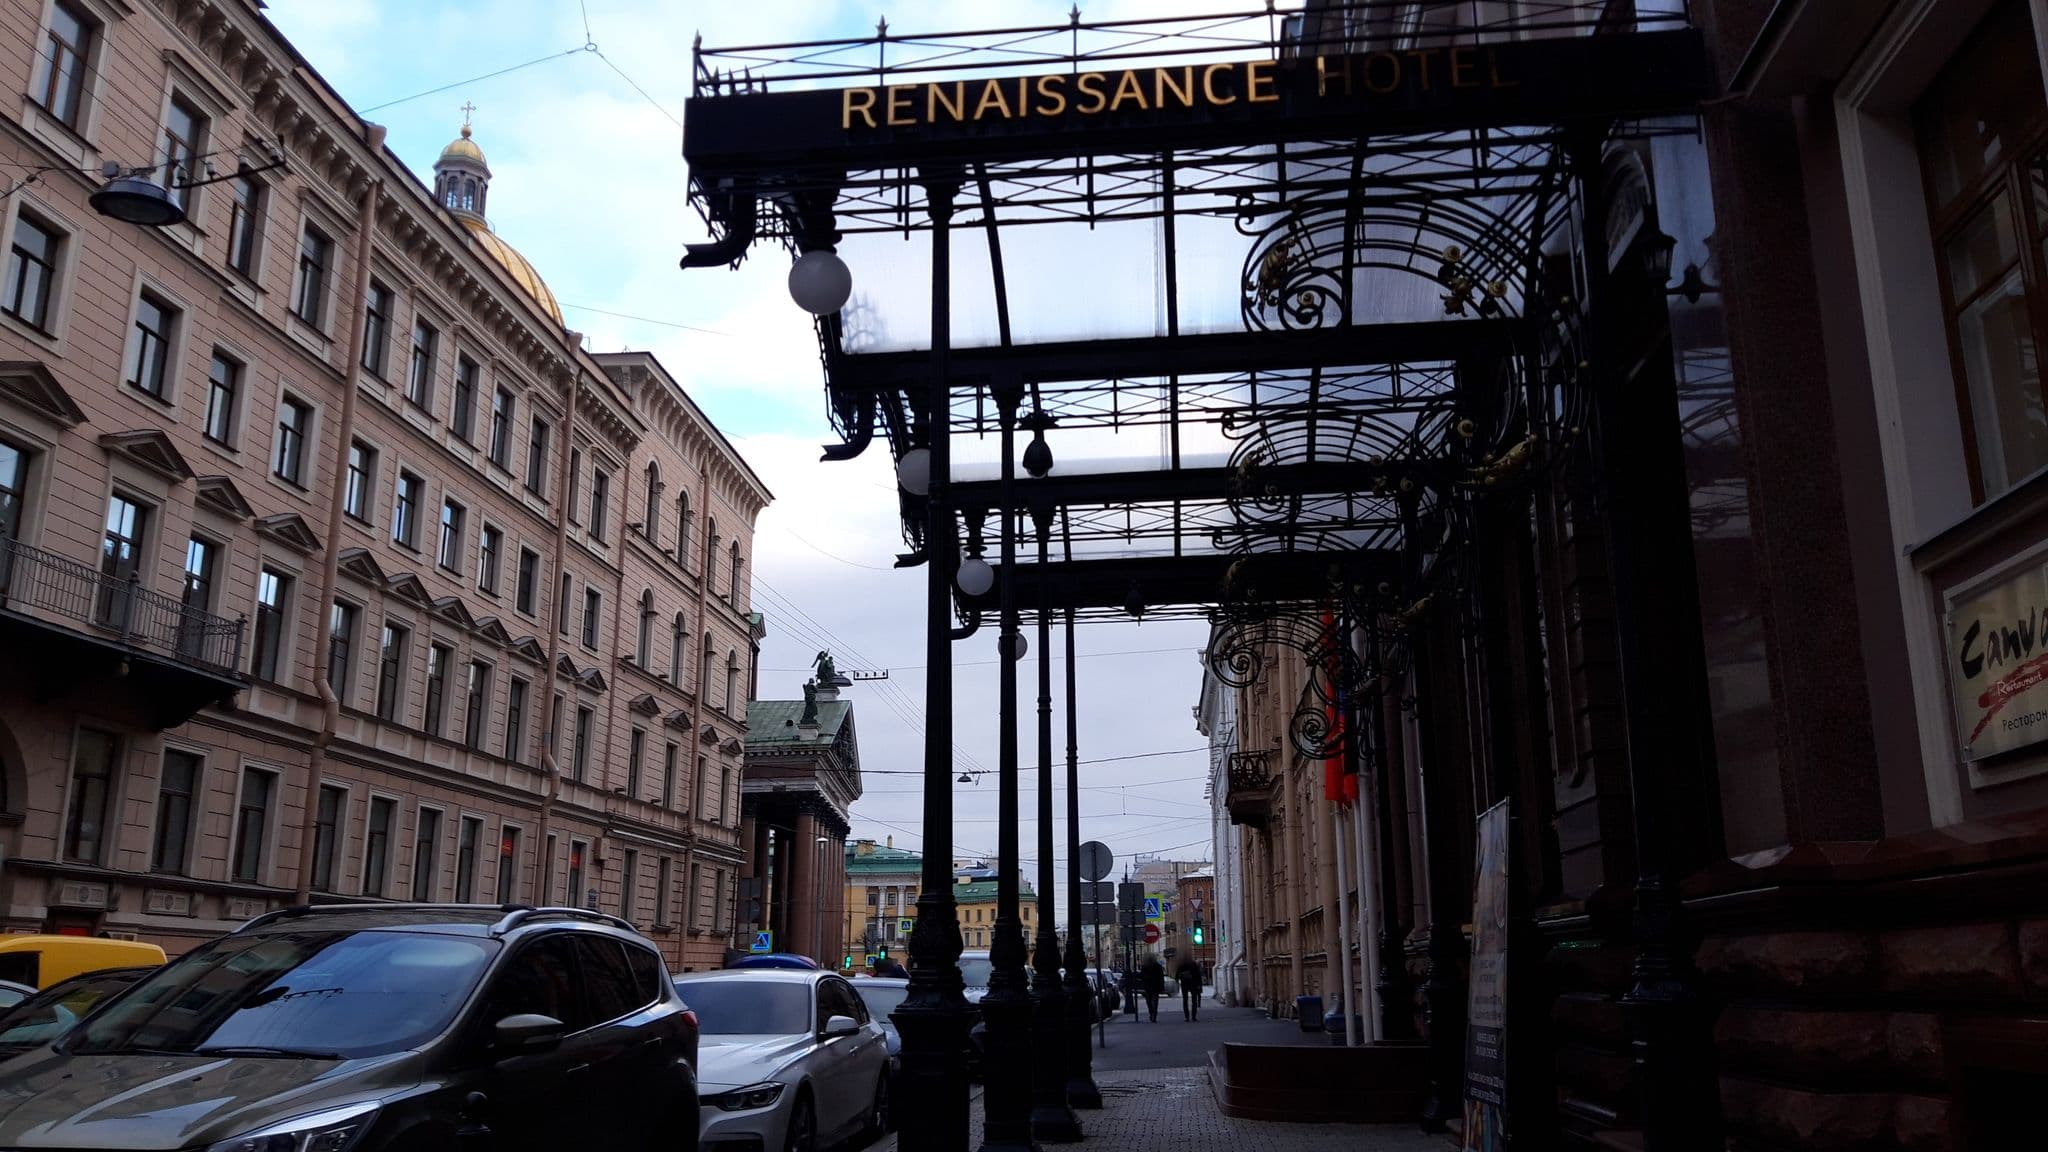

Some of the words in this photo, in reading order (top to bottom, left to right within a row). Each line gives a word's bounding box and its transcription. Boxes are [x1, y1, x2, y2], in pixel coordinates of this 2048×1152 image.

[842, 60, 1280, 129] RENAISSANCE
[1315, 47, 1521, 97] HOTEL
[2002, 709, 2048, 733] Ресторан
